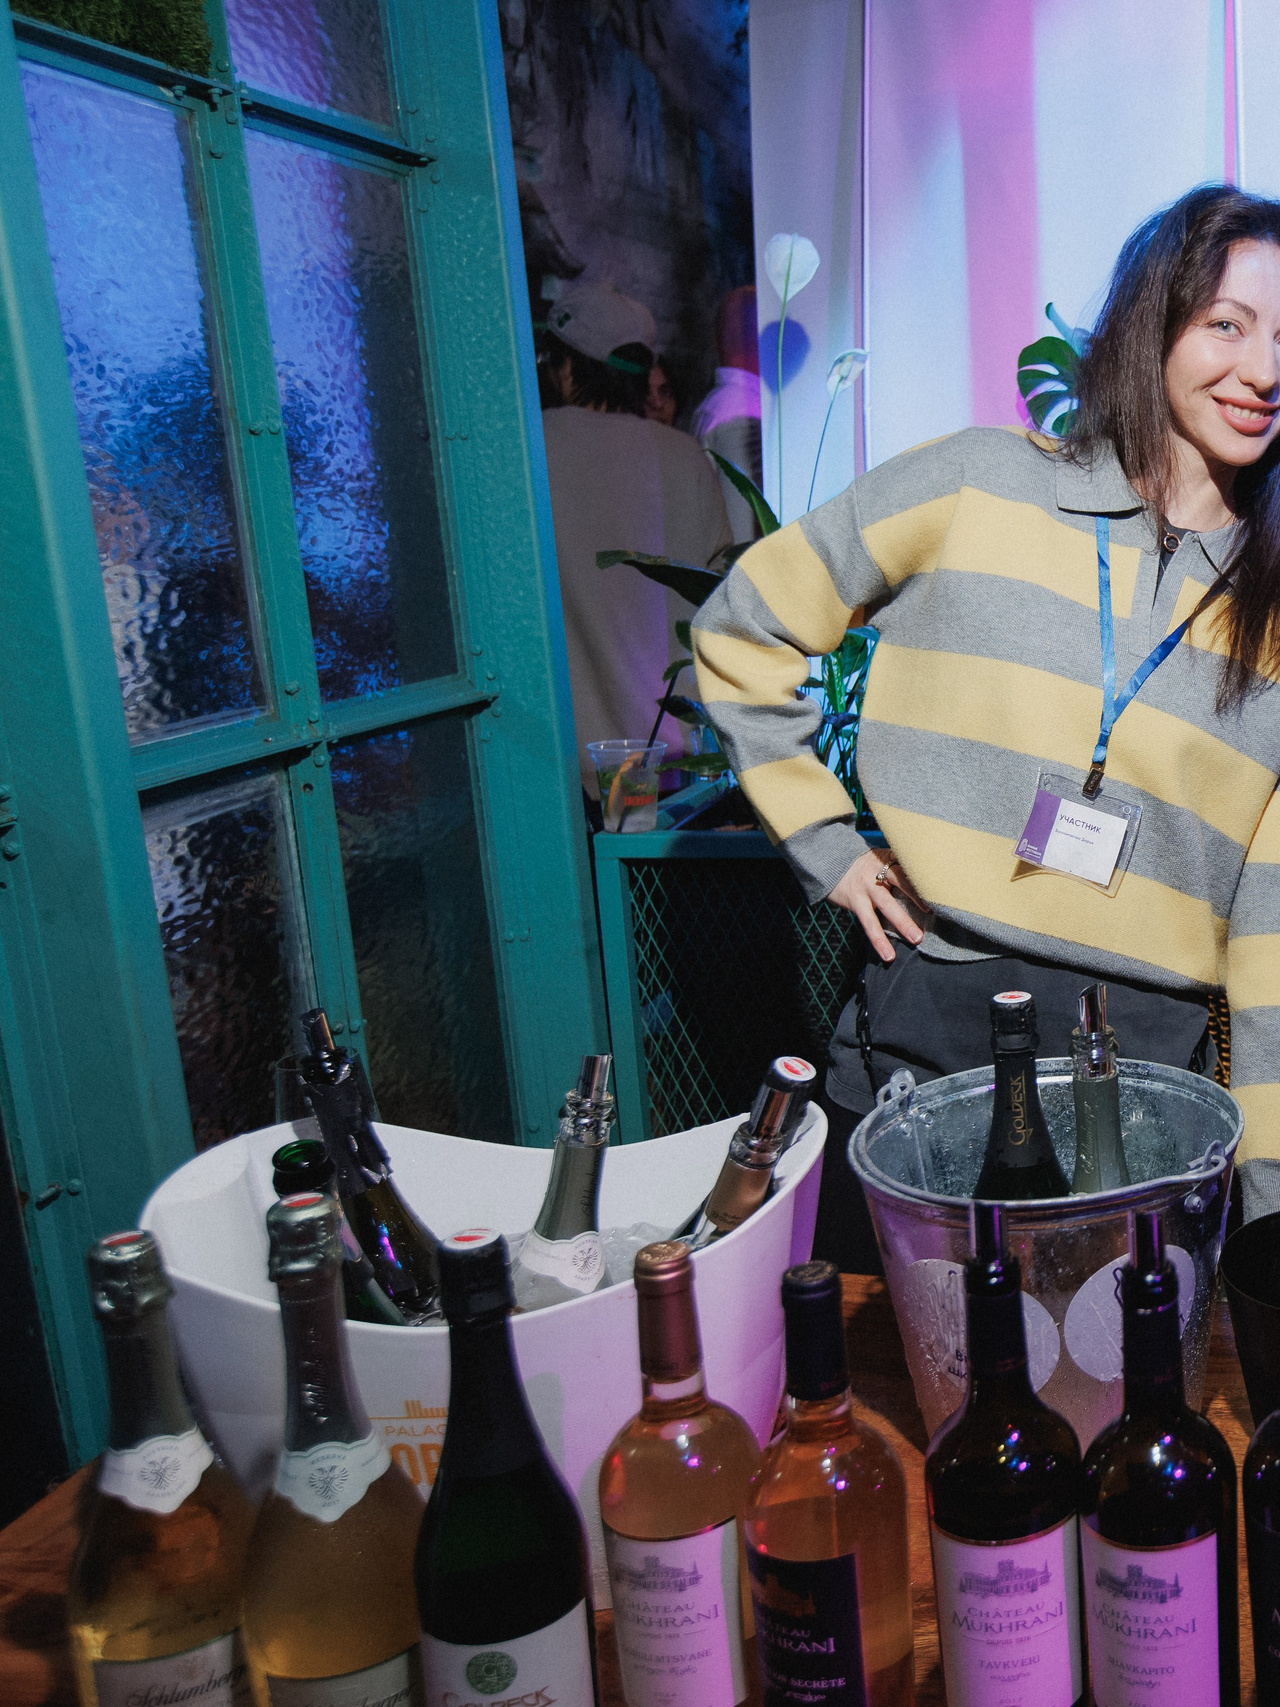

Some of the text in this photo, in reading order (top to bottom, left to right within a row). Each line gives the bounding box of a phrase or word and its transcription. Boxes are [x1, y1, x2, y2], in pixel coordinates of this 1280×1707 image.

[1060, 814, 1101, 834] УЧАСТНИК
[1008, 1073, 1029, 1146] GOLDECK
[384, 1423, 447, 1437] PALAC
[311, 1453, 347, 1465] RESERVE
[618, 1603, 719, 1628] UKHRANI
[952, 1601, 1064, 1634] MUKHRANI
[967, 1601, 1045, 1618] CHÂTEAU
[1092, 1602, 1197, 1639] MUKHRANI
[1103, 1602, 1175, 1624] CHÂTEAU
[978, 1654, 1041, 1670] TAVKVERI
[127, 1664, 248, 1707] Schlumberg
